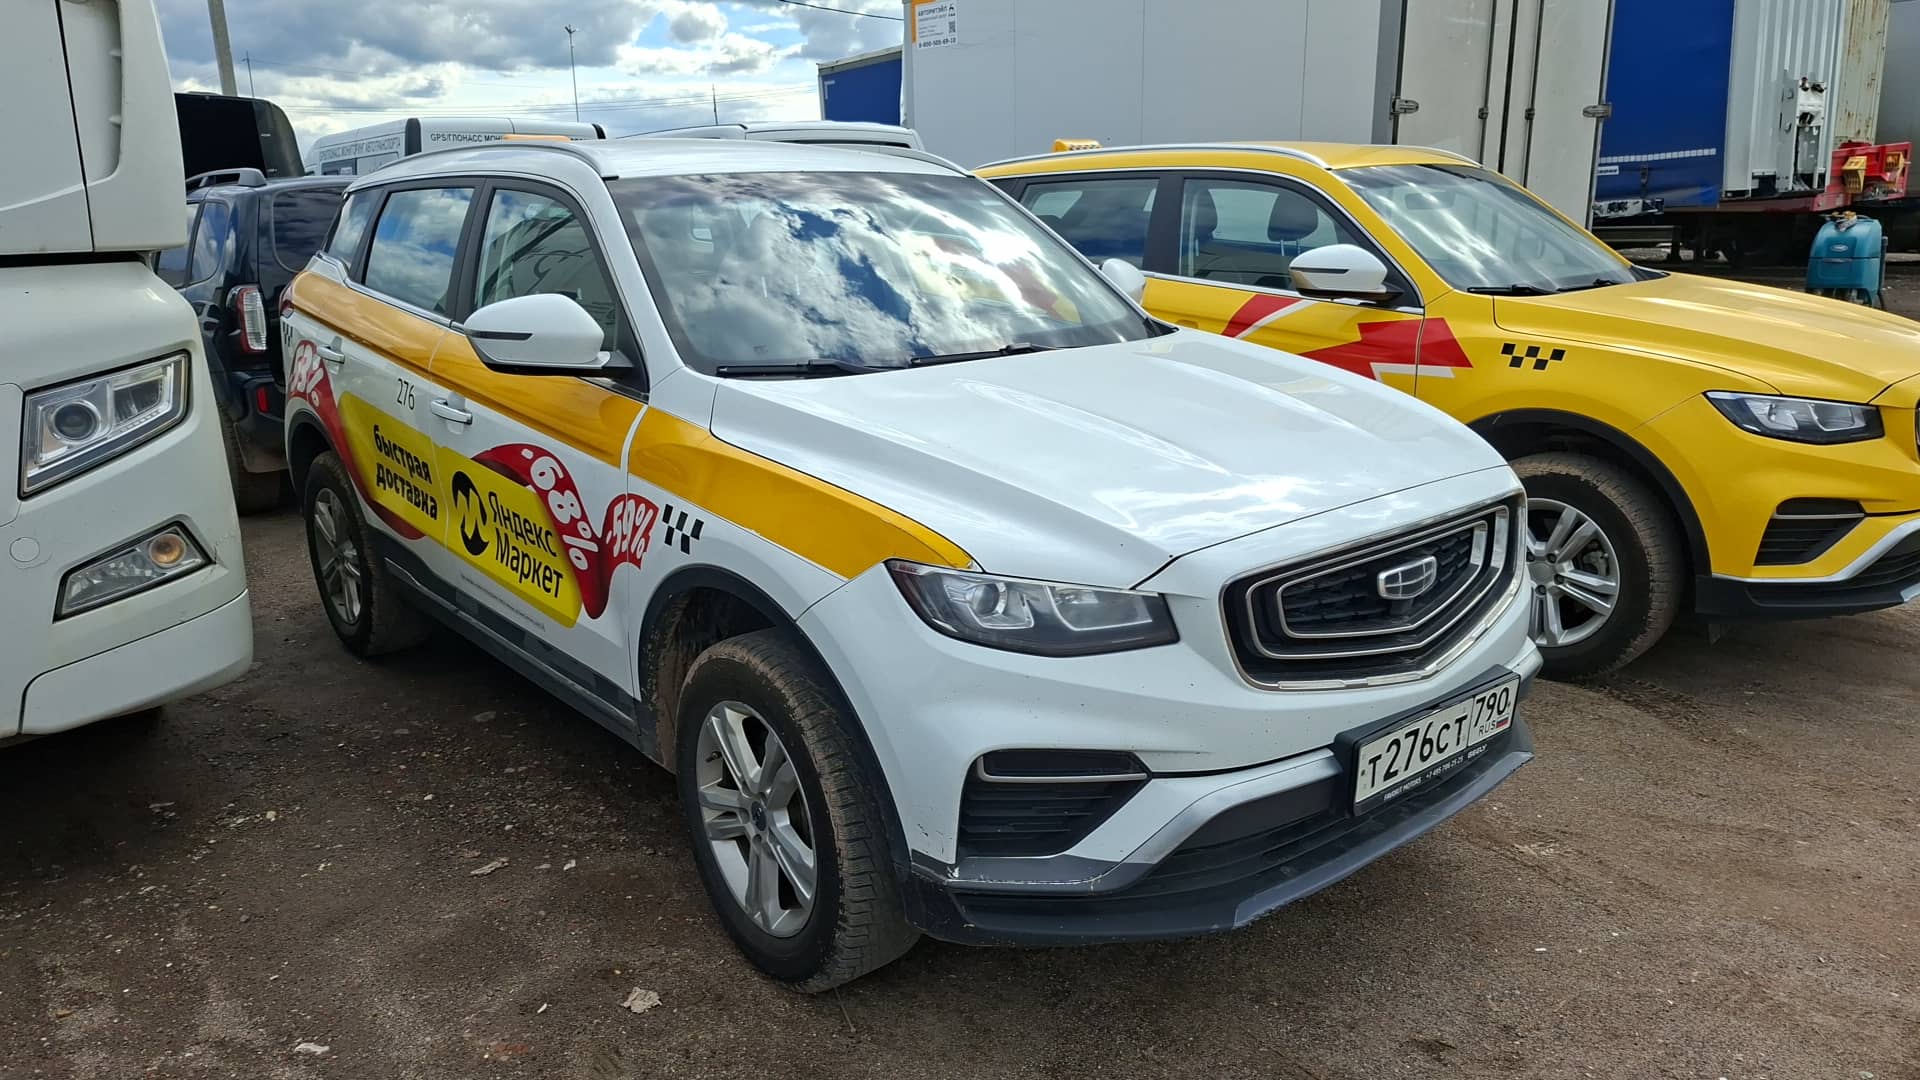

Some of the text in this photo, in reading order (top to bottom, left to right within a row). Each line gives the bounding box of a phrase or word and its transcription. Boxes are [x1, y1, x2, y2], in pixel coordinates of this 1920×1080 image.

[430, 133, 483, 143] GPS/ГЛОНАСС
[397, 378, 415, 410] 276
[373, 424, 433, 485] быстрая
[376, 463, 438, 520] доставка
[521, 448, 599, 570] -68%
[488, 491, 558, 557] Яндекс
[495, 528, 564, 598] Маркет
[1474, 687, 1509, 728] 790
[1478, 719, 1497, 737] RUS
